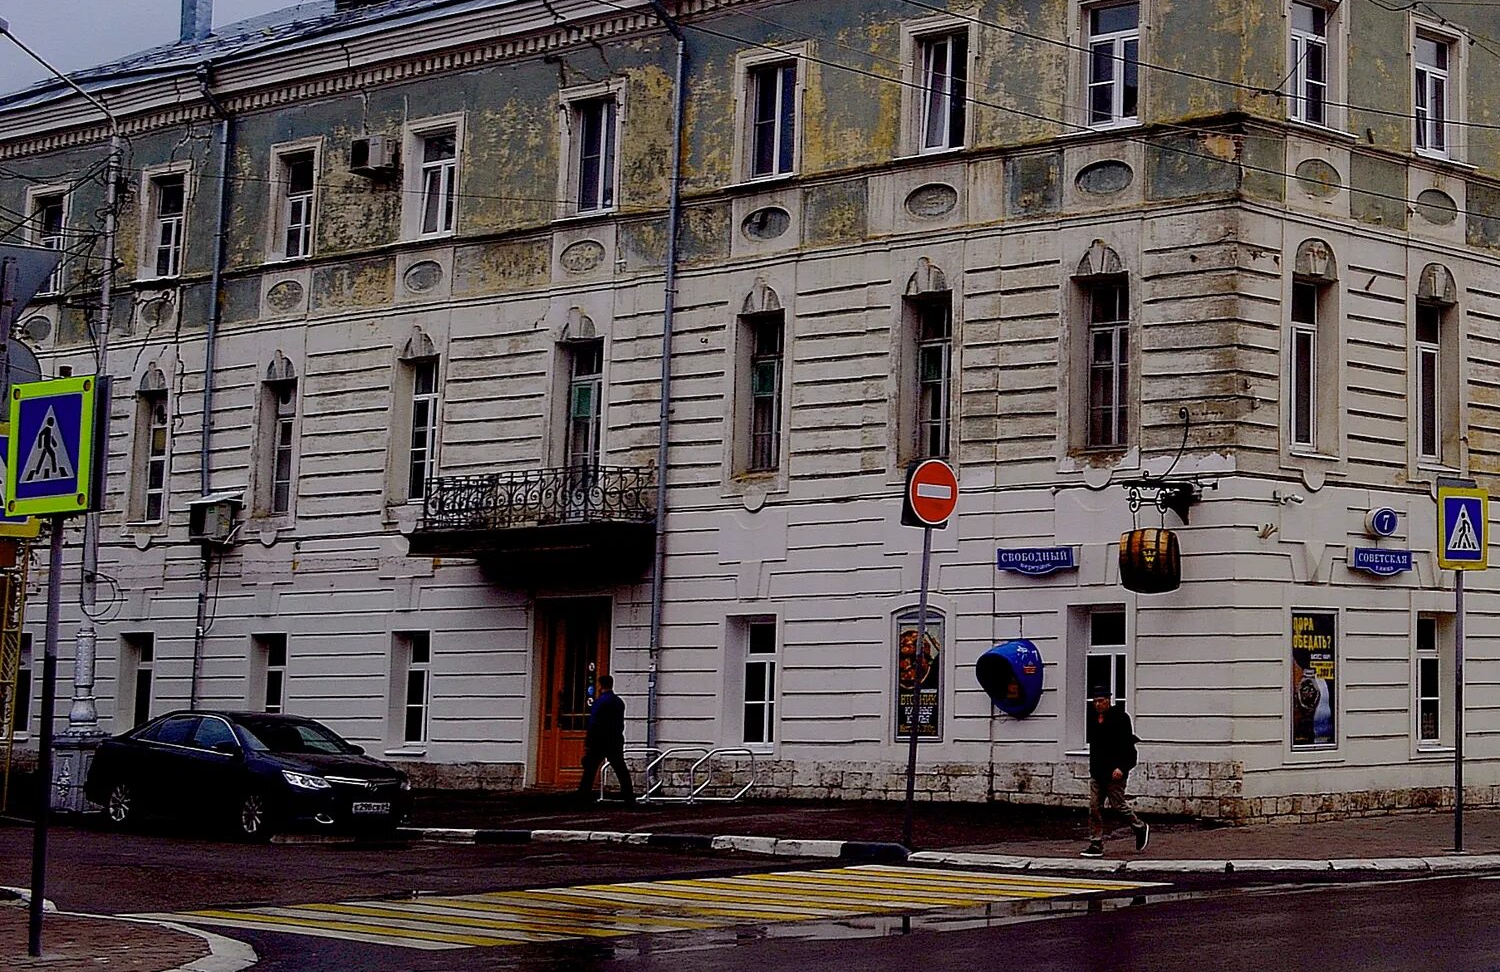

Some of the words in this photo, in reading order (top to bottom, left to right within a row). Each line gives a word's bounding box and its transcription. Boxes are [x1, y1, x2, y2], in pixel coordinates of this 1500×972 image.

[1383, 514, 1390, 531] 7
[1001, 550, 1068, 562] СВОБОДНЫЙ
[1358, 553, 1408, 564] СОВЕТСКАЯ
[1293, 617, 1314, 631] ПОРА
[1293, 635, 1332, 651] ОБЕДАТЬ?
